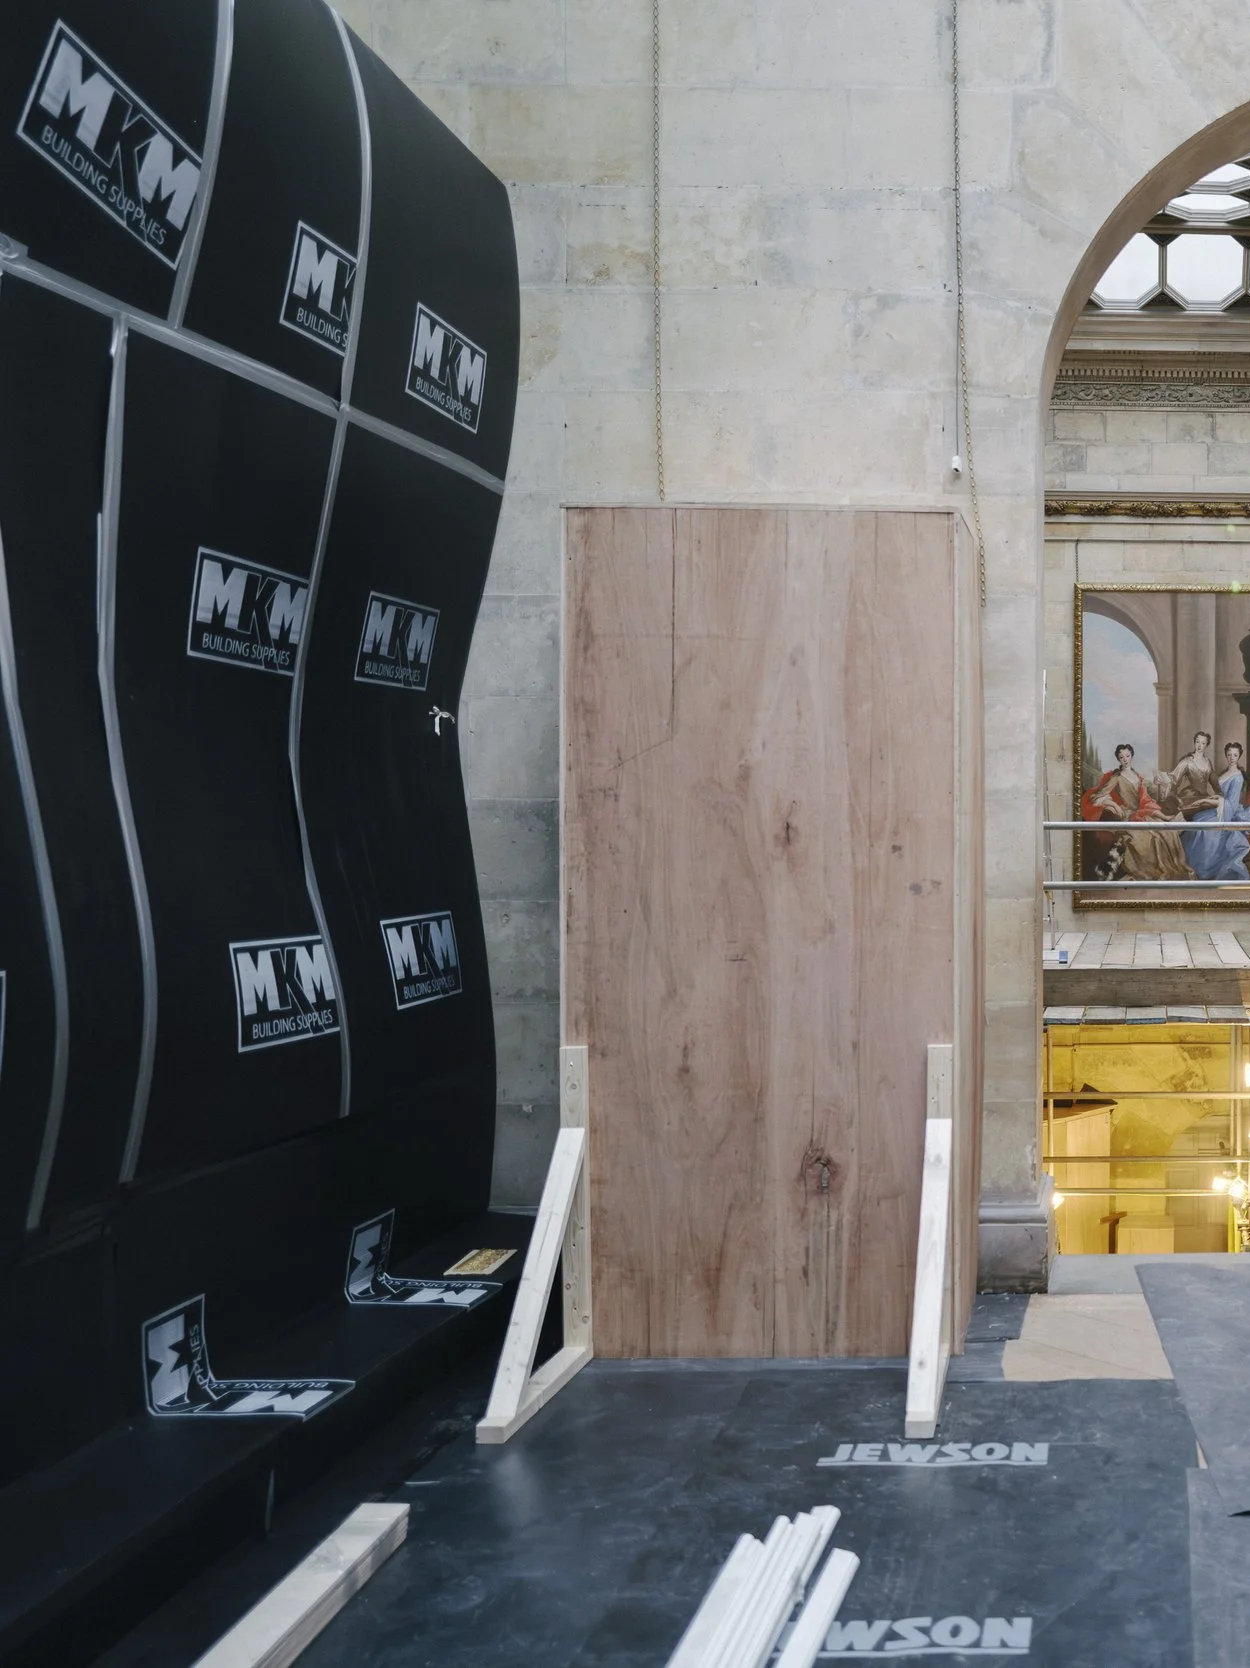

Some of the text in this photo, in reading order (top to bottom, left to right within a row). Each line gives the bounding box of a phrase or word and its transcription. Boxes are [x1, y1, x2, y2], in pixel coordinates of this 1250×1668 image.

[39, 38, 201, 236] MKM
[41, 124, 168, 246] BUILDING SUPPLIES
[292, 233, 357, 324] MK
[296, 306, 342, 343] BUILDING
[413, 312, 485, 412] MKM
[415, 375, 446, 408] BUILDING
[196, 558, 310, 650] MKM
[362, 599, 436, 670] MKM
[202, 631, 290, 667] BUILDING SUPPLIES
[364, 660, 394, 678] BUILDING
[236, 943, 336, 1018] MKM
[387, 918, 457, 982] MKM
[403, 979, 432, 999] BUILDING
[252, 1008, 334, 1040] BUILDING SUPPLIES
[816, 1442, 1050, 1466] JEWSON
